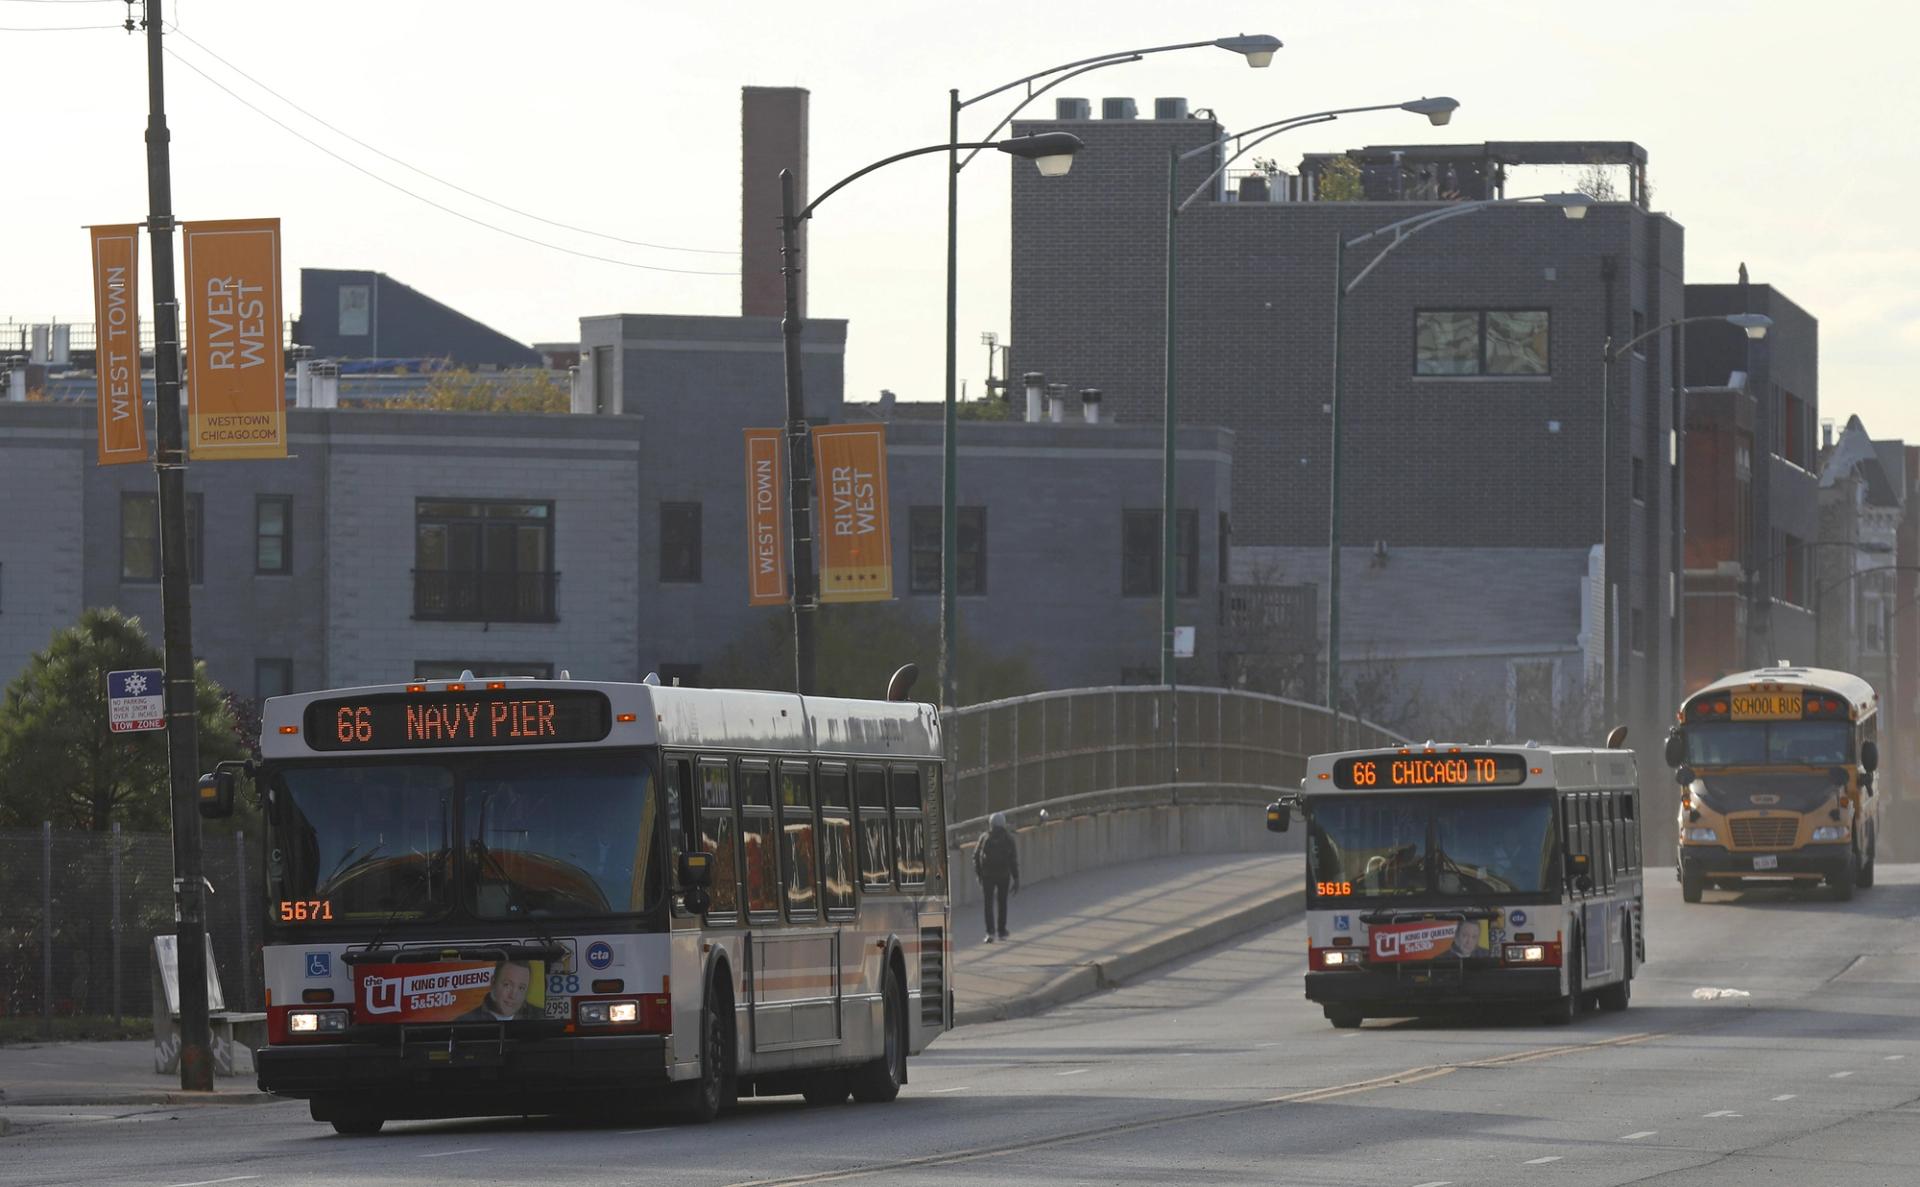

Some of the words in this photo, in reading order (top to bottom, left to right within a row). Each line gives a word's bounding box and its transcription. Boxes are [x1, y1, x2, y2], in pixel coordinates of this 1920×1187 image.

[107, 266, 126, 340] TOWN
[208, 275, 234, 370] RIVER
[238, 279, 265, 369] WEST
[111, 352, 129, 421] WEST
[201, 428, 277, 441] CHICAGO.COM
[207, 415, 270, 427] WESTTOWN
[757, 460, 772, 514] TOWN
[832, 466, 853, 535] RIVER
[855, 468, 876, 534] WEST
[759, 523, 774, 574] WEST
[337, 706, 373, 743] 66
[406, 702, 480, 740] NAVY
[491, 700, 557, 738] PIER
[1733, 697, 1774, 715] SCHOOL
[1778, 697, 1801, 714] BUS
[114, 722, 133, 730] TOW
[137, 720, 161, 729] ZONE
[1353, 761, 1376, 785] 66
[1392, 759, 1469, 784] CHICAGO
[1474, 758, 1496, 783] TO
[1316, 882, 1351, 896] 5616
[281, 900, 333, 921] 5671
[365, 976, 382, 987] the
[411, 979, 436, 991] KING
[437, 977, 450, 988] OF
[451, 971, 490, 988] QUEENS
